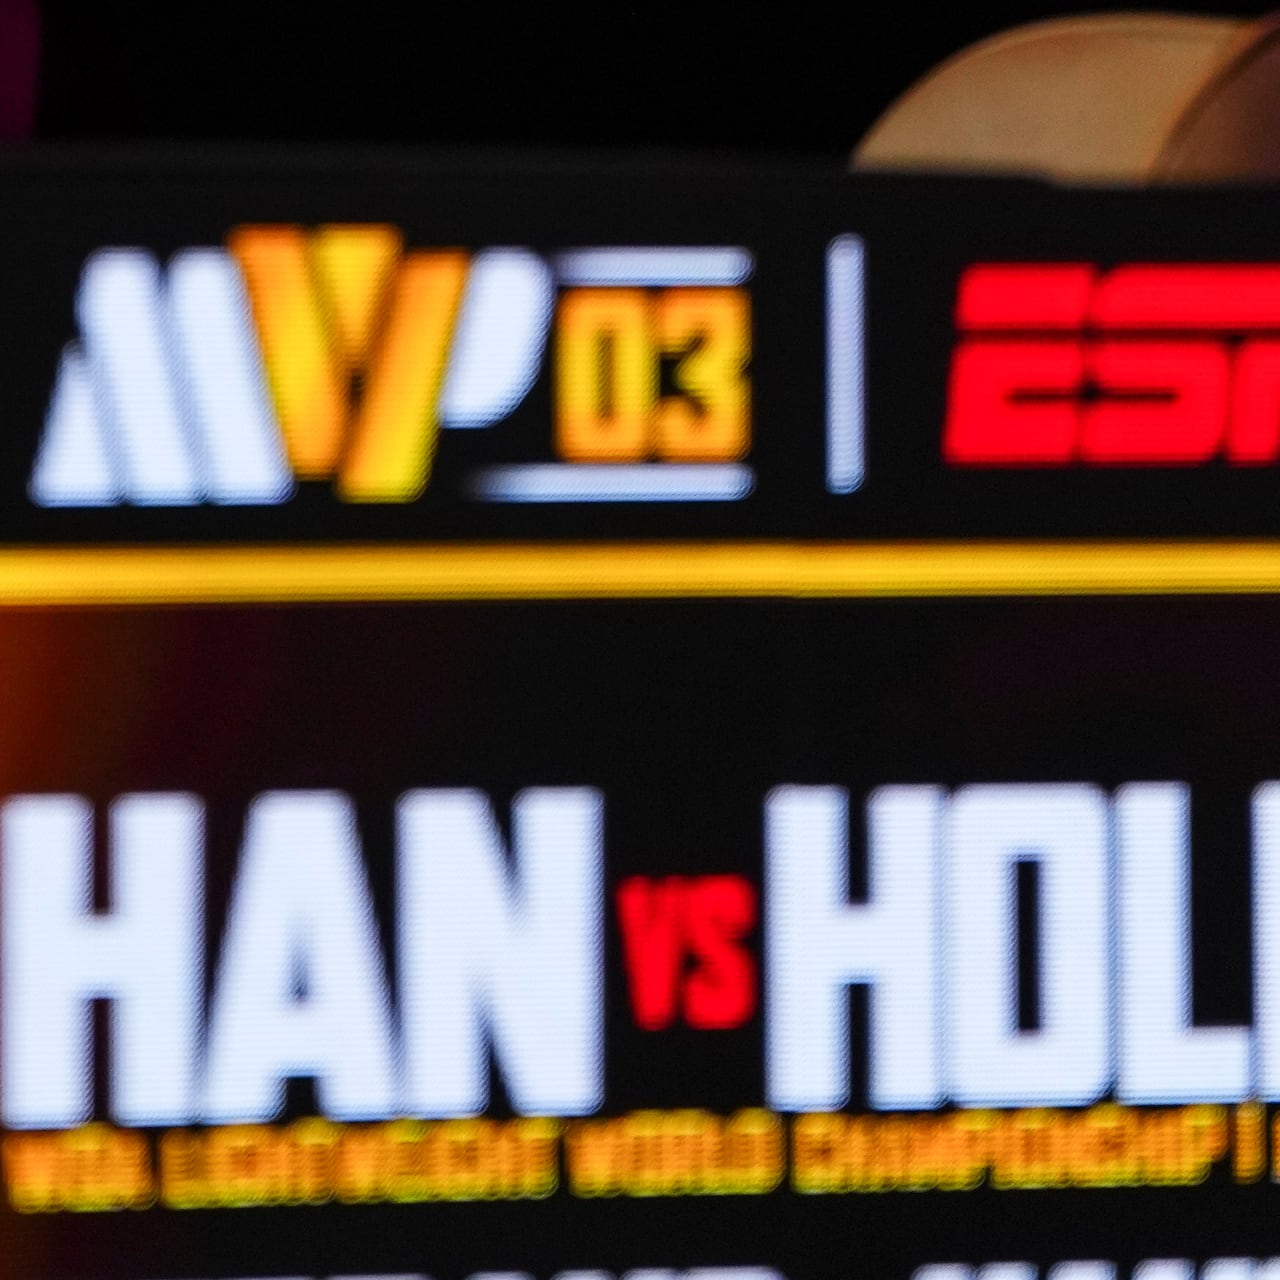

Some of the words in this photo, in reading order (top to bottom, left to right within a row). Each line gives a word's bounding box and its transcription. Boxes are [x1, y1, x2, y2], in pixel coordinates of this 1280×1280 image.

[555, 286, 751, 462] 03
[617, 875, 757, 1030] VS
[764, 780, 1280, 1113] HOL
[567, 1110, 784, 1198] WORLD
[792, 1104, 1228, 1194] CHAMPIONSHIP
